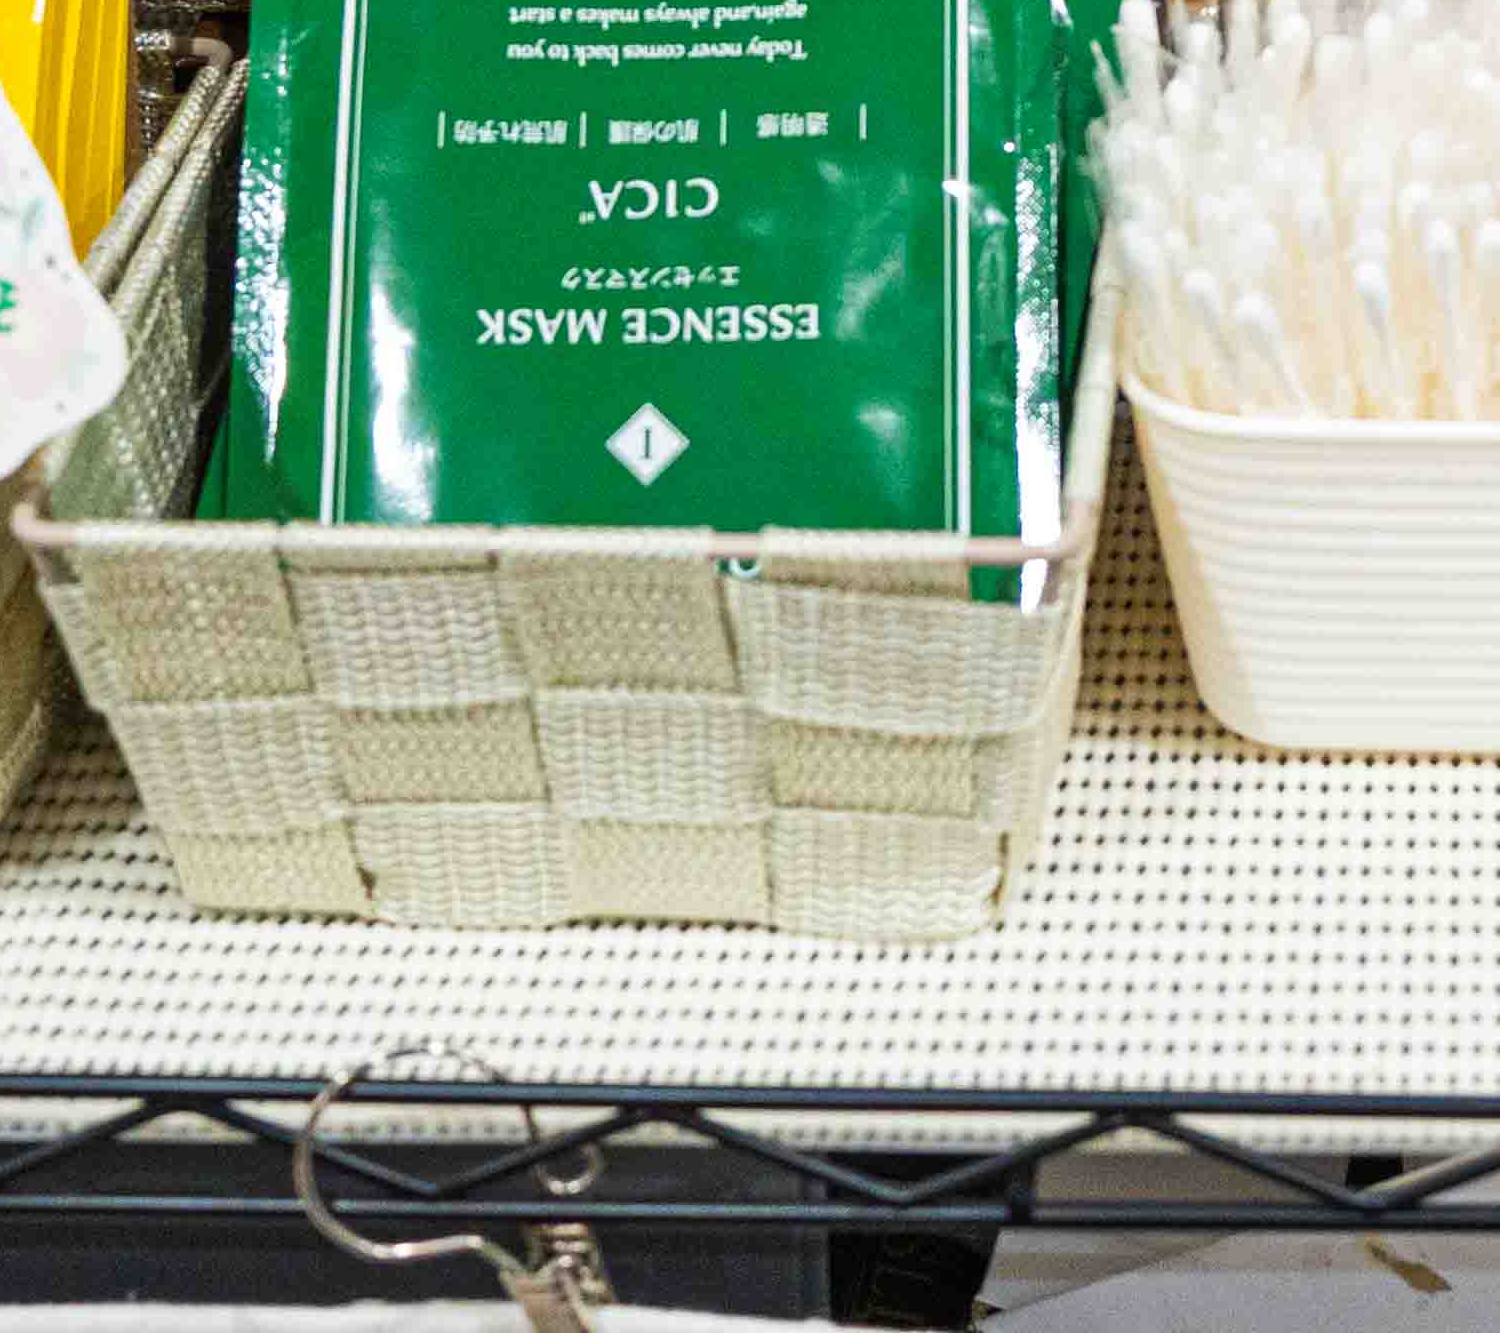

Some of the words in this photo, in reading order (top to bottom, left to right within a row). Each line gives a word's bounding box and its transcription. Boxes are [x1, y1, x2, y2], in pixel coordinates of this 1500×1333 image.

[509, 7, 556, 23] start
[559, 8, 572, 22] a
[576, 7, 639, 31] makes
[644, 2, 709, 30] always
[507, 38, 546, 59] you
[548, 44, 570, 60] to
[574, 44, 619, 67] back
[622, 44, 686, 59] comes
[688, 44, 742, 58] never
[746, 36, 808, 63] Today
[561, 265, 741, 291] エッセンスマスク
[475, 307, 608, 346] MASK
[622, 303, 820, 345] ESSENCE
